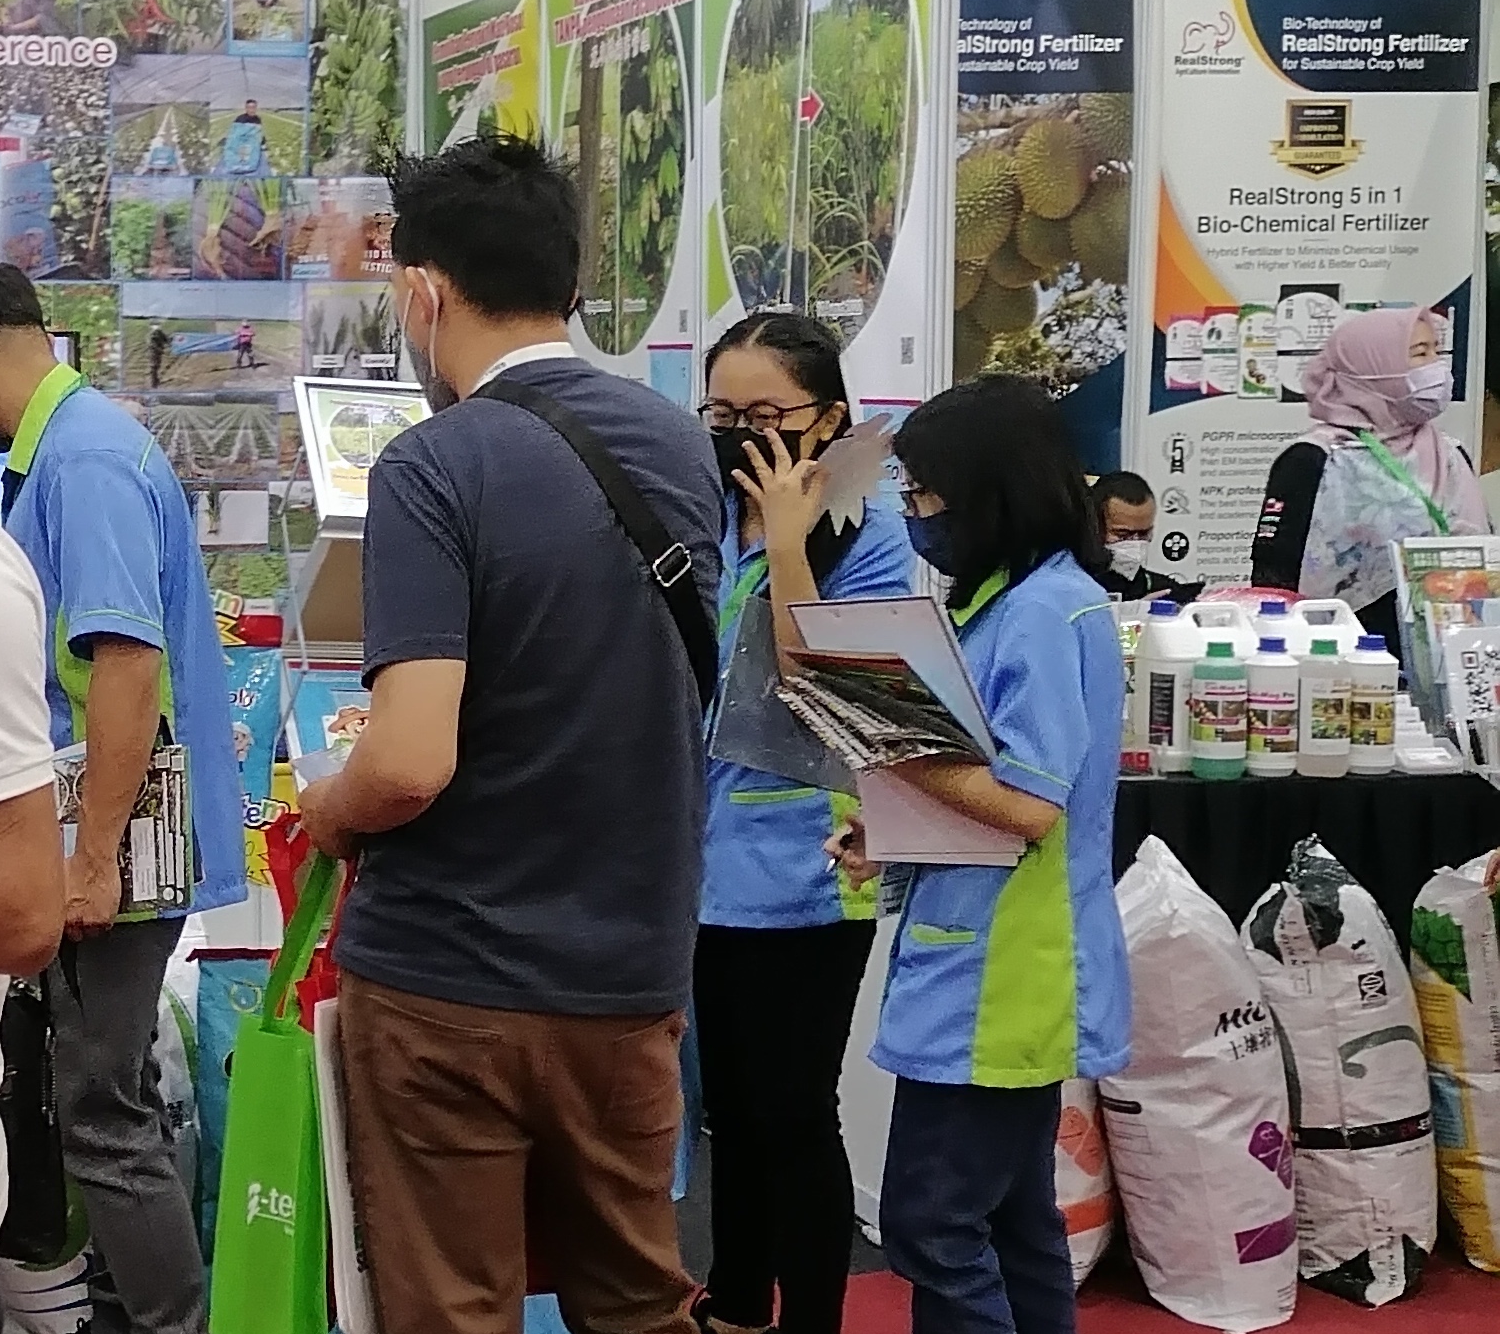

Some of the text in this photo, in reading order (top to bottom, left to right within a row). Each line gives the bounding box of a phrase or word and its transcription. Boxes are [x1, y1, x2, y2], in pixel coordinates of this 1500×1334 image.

[1020, 18, 1033, 31] of
[1282, 17, 1382, 33] Bio-Technology of
[1039, 34, 1124, 54] Fertilizer
[1282, 34, 1470, 56] RealStrong Fertilizer
[1016, 58, 1046, 74] Crop
[1049, 58, 1080, 71] Yield
[1174, 55, 1242, 67] RealStrong
[1282, 57, 1425, 73] for Sustainable Crop Yield
[1229, 186, 1402, 209] RealStrong 5 in 1
[1197, 214, 1430, 233] Bio-Chemical Fertilizer
[1206, 245, 1419, 259] Hybrid Fertilizer to Minimize Chemical Usage
[1257, 259, 1289, 271] Higher
[1292, 259, 1316, 269] Yield
[1329, 258, 1356, 268] Better
[1359, 258, 1392, 270] Quality
[1200, 486, 1224, 496] NPK
